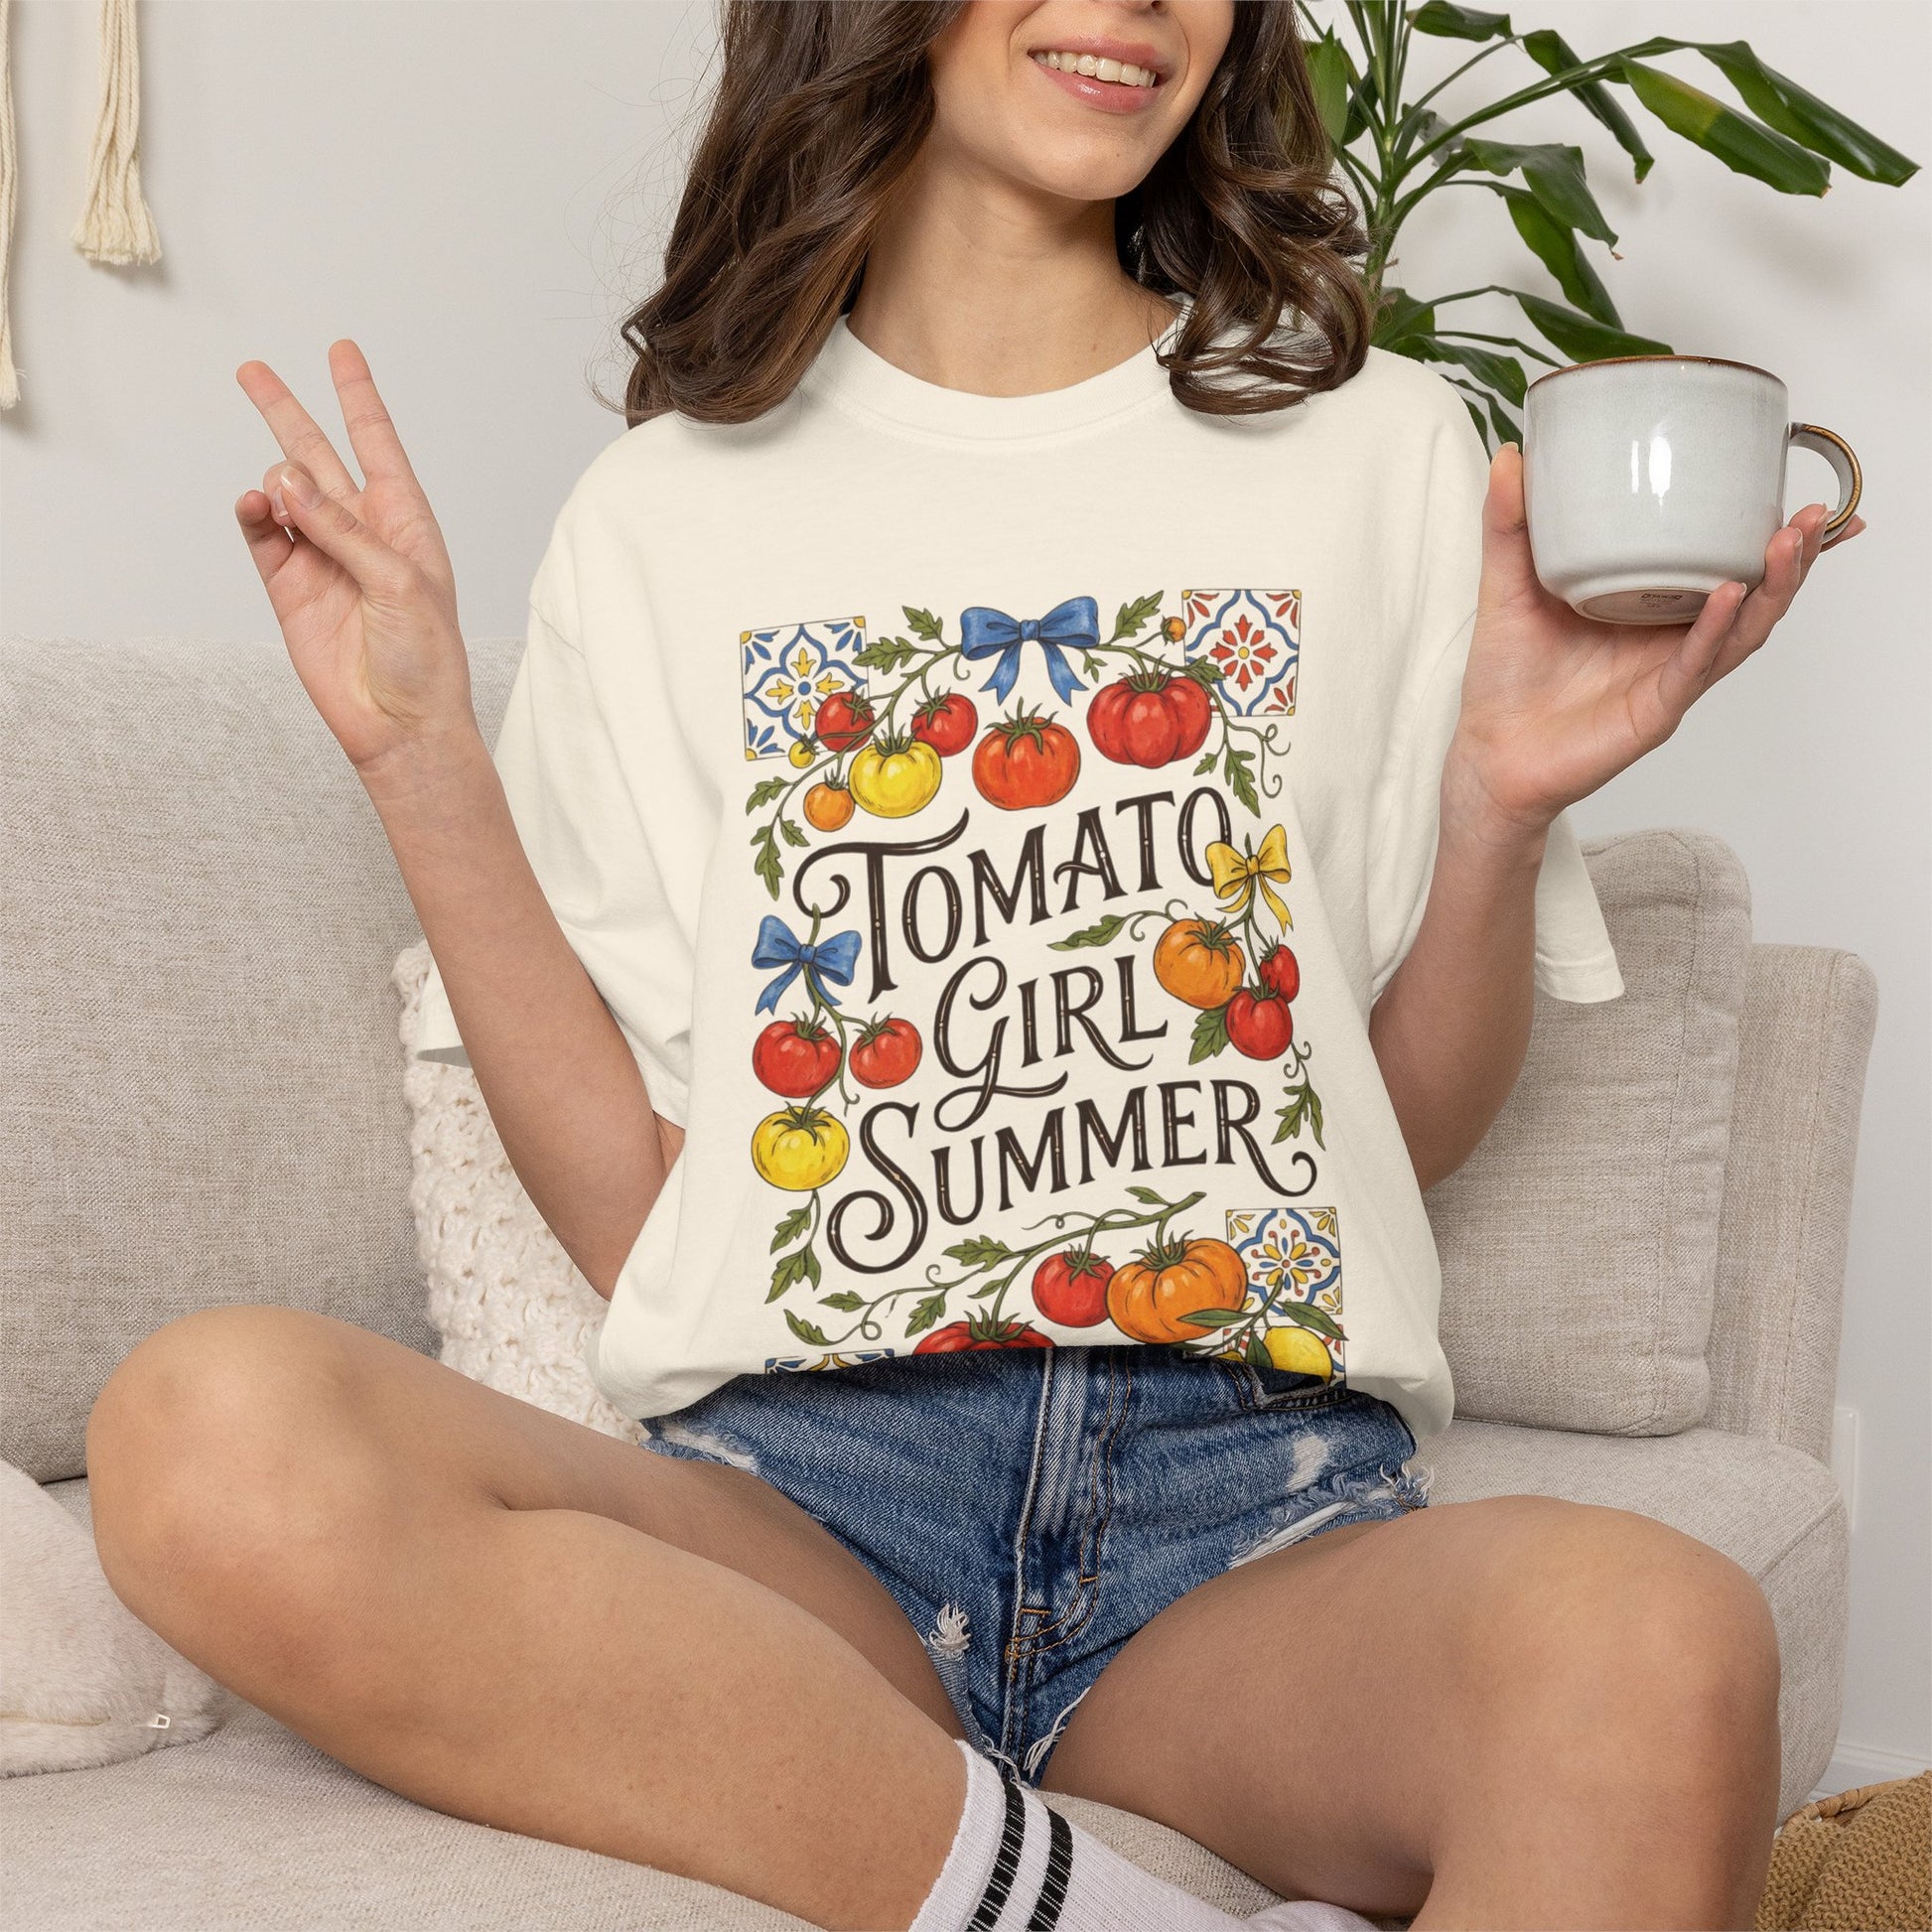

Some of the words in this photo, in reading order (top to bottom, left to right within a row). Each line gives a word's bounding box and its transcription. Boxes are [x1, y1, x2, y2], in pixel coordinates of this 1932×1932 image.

[794, 786, 1231, 1004] TOMATO
[933, 956, 1168, 1133] GIRL
[826, 1079, 1317, 1274] SUMMER
